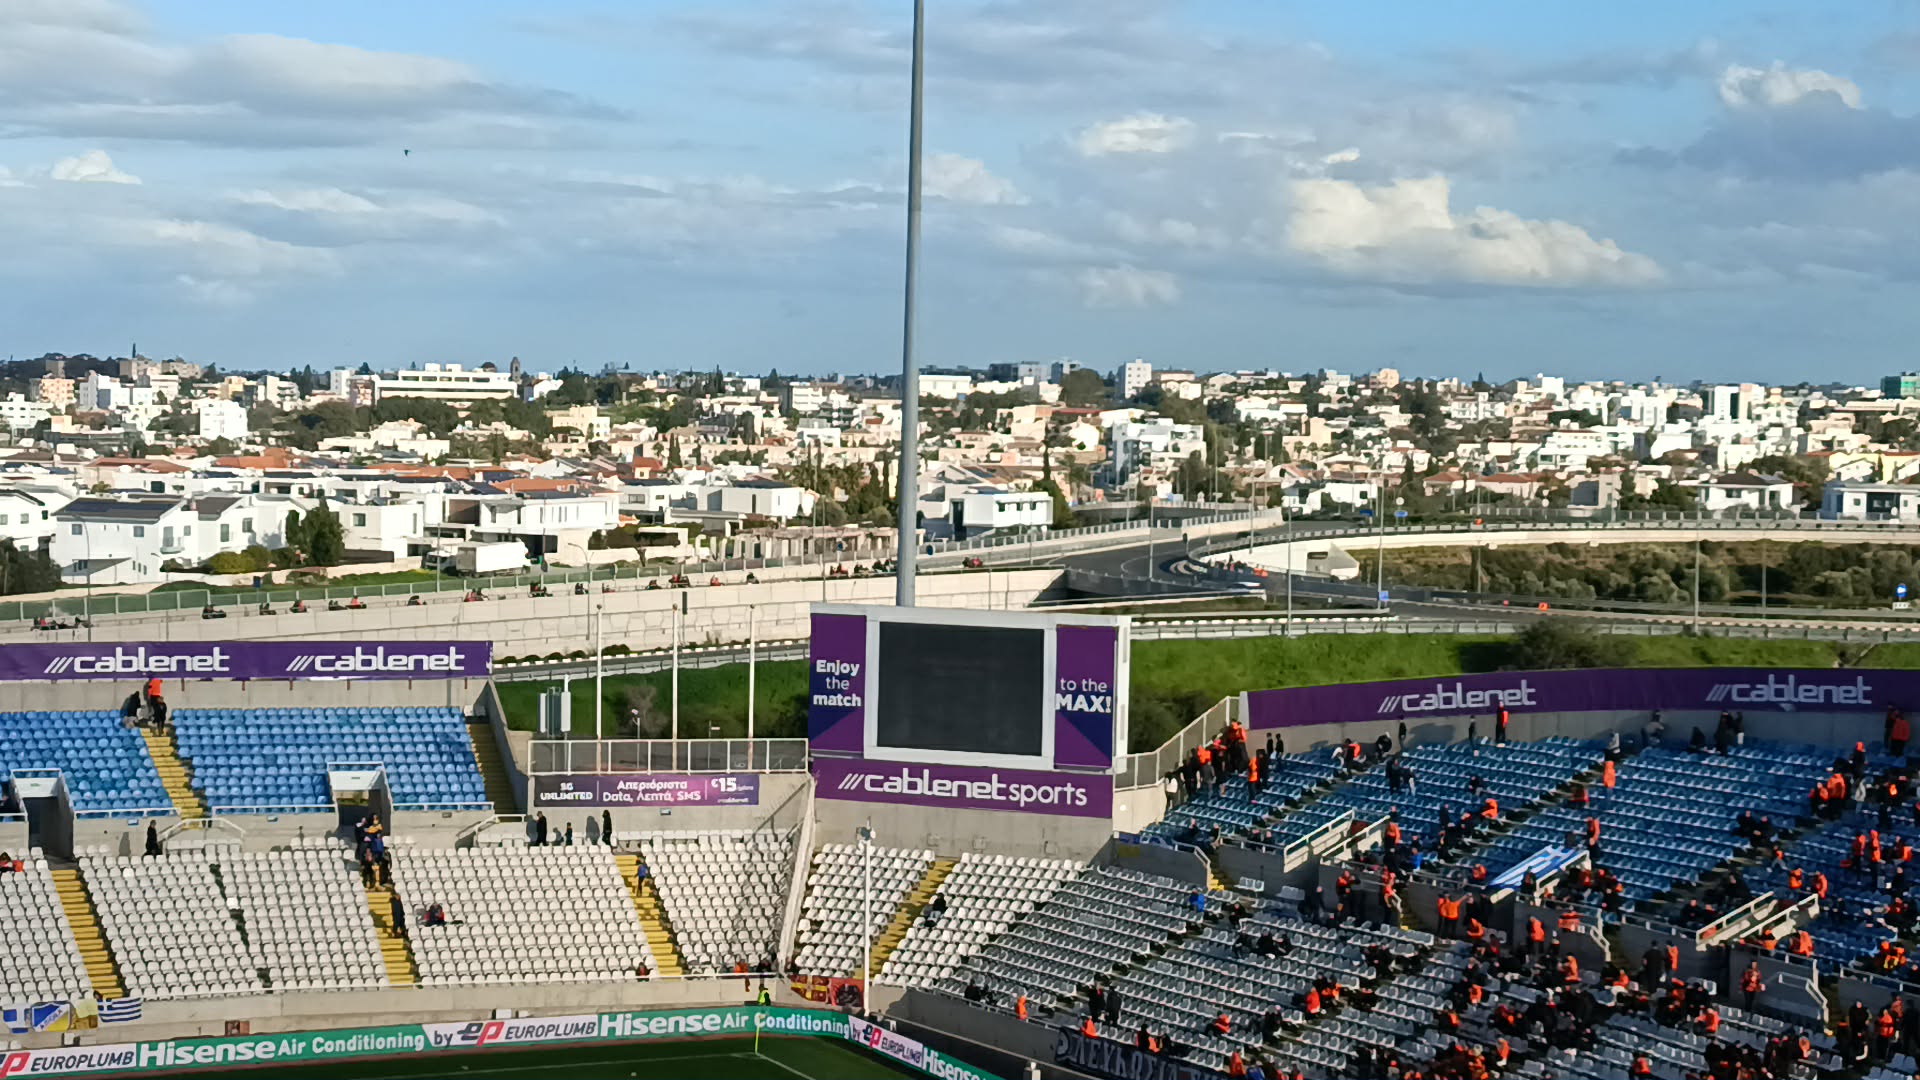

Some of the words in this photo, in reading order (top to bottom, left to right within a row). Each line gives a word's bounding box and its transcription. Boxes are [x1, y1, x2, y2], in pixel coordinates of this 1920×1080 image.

[73, 646, 230, 673] cablenet
[314, 646, 465, 671] cablenet
[816, 659, 860, 676] Enjoy
[825, 677, 850, 690] the
[1060, 677, 1076, 692] to
[1081, 678, 1108, 693] the
[1731, 674, 1872, 704] cablenet
[813, 694, 862, 707] match
[1055, 693, 1112, 714] MAX!
[1401, 679, 1536, 712] cablenet
[677, 790, 702, 801] SMS
[434, 1030, 453, 1047] by
[505, 1021, 597, 1040] EUROPLUMB
[600, 1012, 721, 1037] Hisense
[723, 1012, 749, 1029] Air
[754, 1011, 850, 1041] Conditioning
[30, 1051, 135, 1072] EUROPLUMB
[139, 1040, 275, 1068] Hisense
[277, 1039, 306, 1057] Air
[312, 1032, 425, 1054] Conditioning
